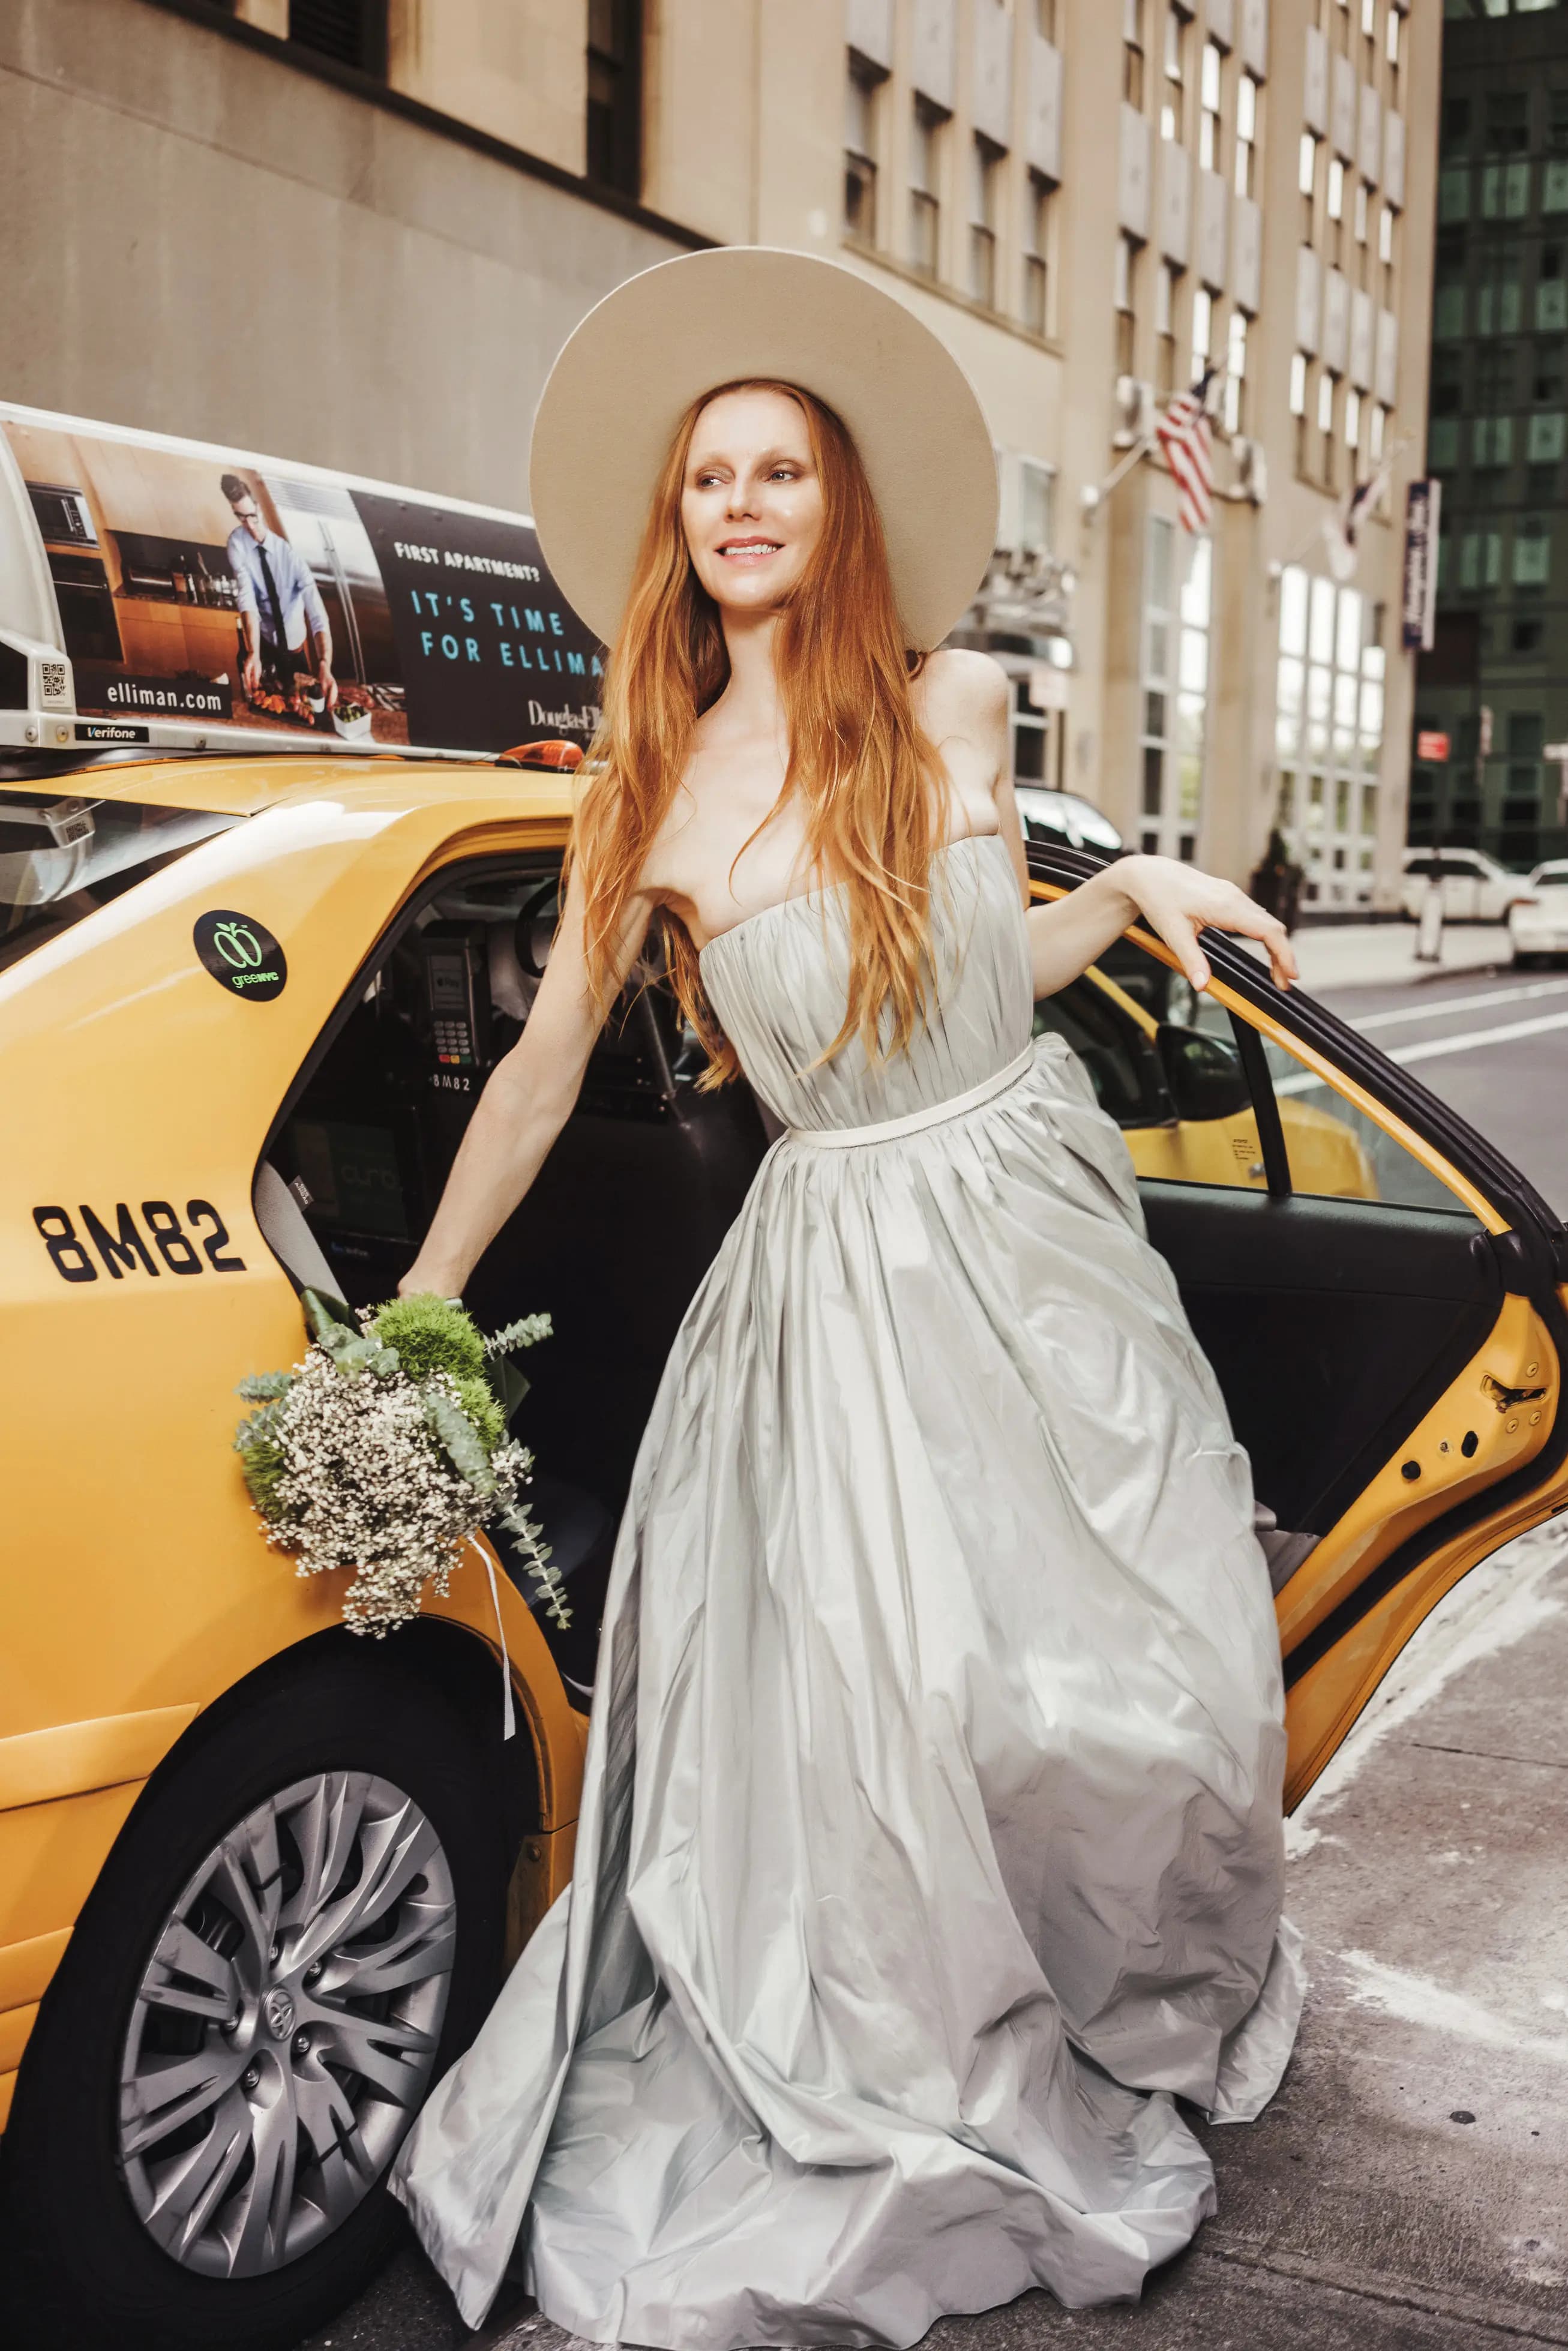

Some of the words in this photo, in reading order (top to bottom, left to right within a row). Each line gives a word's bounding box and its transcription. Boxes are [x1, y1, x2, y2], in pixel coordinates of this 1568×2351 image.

[394, 541, 439, 565] FIRST
[444, 551, 540, 582] APARTMENT?
[411, 590, 475, 622] IT'S
[490, 602, 563, 636] TIME
[421, 631, 481, 662] FOR
[500, 642, 604, 677] ELLIMA
[107, 682, 221, 710] elliman.com
[88, 727, 136, 739] Verifone
[433, 1074, 470, 1091] 8M82
[32, 1199, 247, 1283] 8M82
